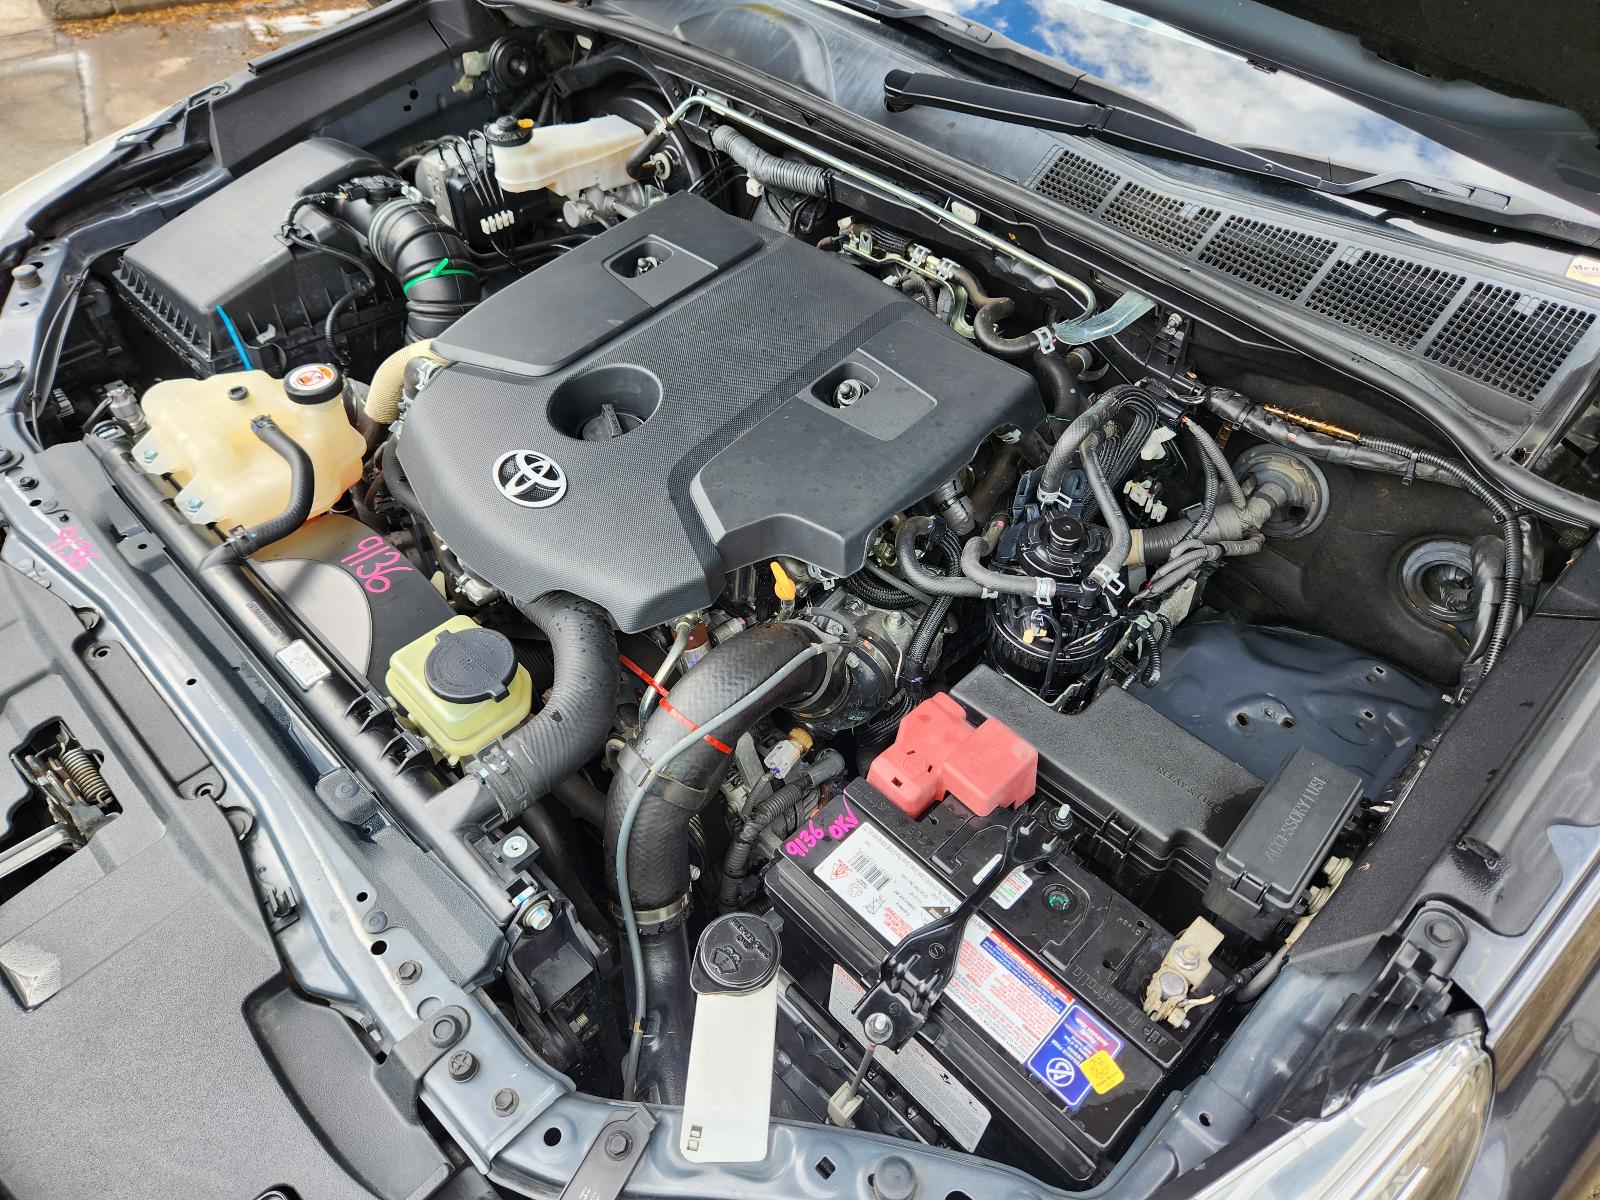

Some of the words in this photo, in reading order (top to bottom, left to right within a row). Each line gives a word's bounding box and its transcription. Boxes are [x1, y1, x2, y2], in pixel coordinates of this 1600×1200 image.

[341, 534, 412, 593] 9136
[1155, 765, 1186, 789] RELAY
[785, 819, 824, 857] 9136
[1264, 799, 1310, 863] ACCESSORY
[1304, 773, 1329, 803] FUSE
[1068, 964, 1129, 1015] Australia
[1066, 1044, 1083, 1061] DESIGN
